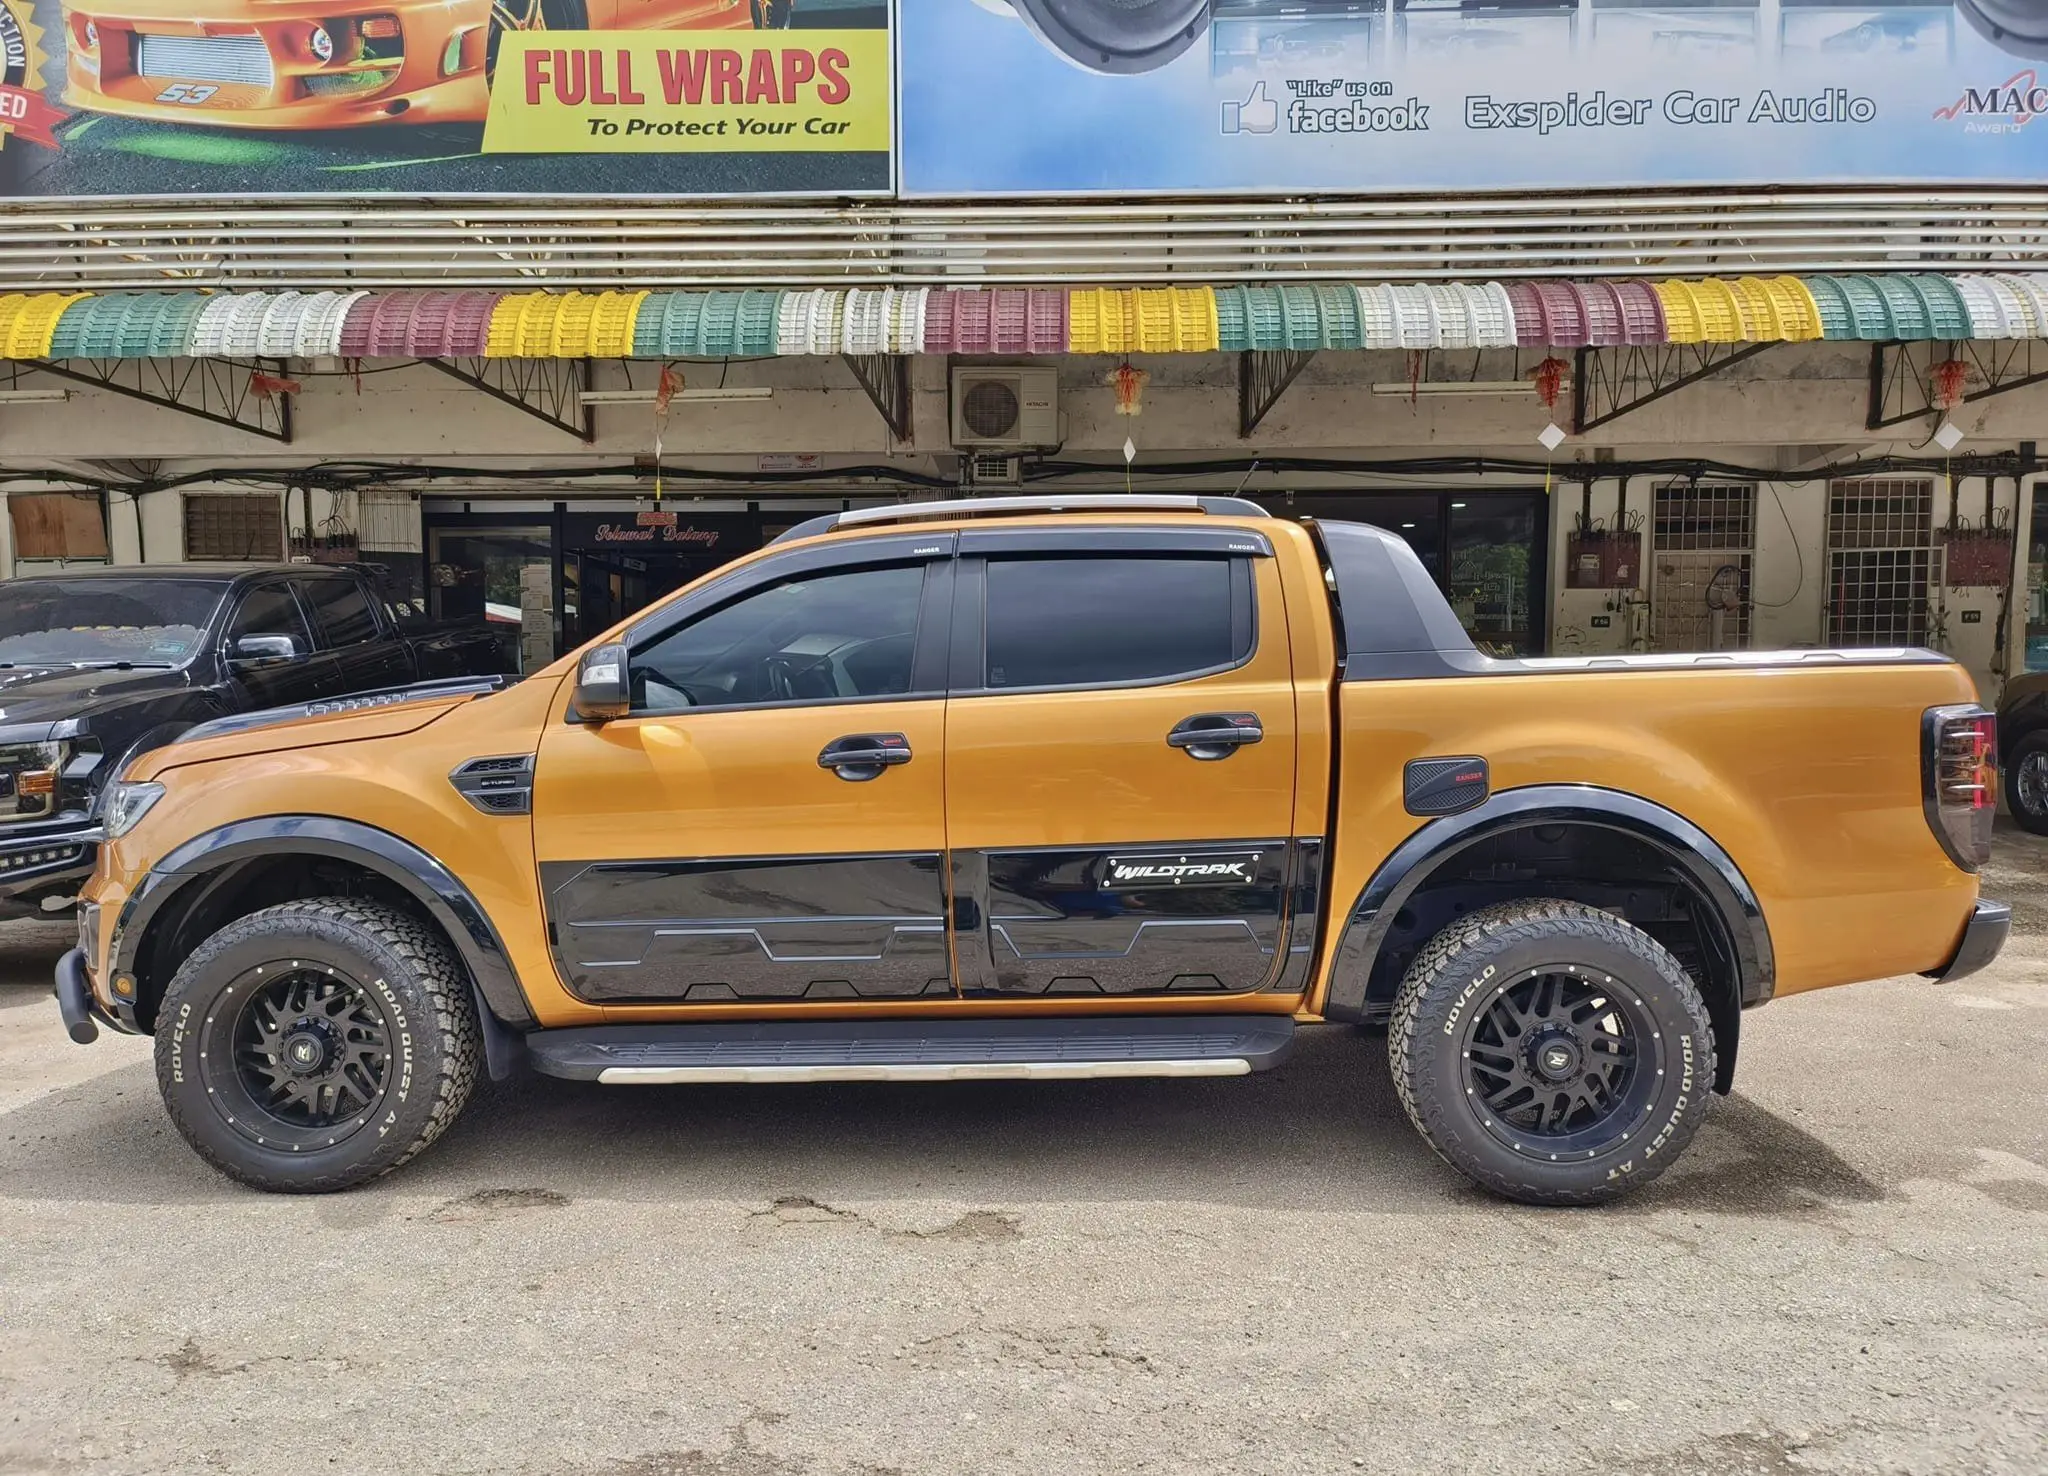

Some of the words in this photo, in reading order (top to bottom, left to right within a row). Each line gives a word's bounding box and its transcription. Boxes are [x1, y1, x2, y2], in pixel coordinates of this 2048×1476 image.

[155, 83, 220, 104] 53
[524, 49, 645, 105] FULL
[656, 47, 851, 105] WRAPS
[1345, 82, 1366, 97] us
[1369, 81, 1393, 96] on
[587, 118, 619, 136] To
[625, 118, 727, 136] Protect
[736, 118, 797, 136] Your
[804, 117, 851, 135] Car
[1288, 97, 1430, 133] facebook
[1465, 90, 1652, 135] Exspider
[1662, 90, 1740, 123] Car
[1748, 88, 1877, 123] Audio
[1964, 121, 2022, 134] Award
[594, 523, 656, 542] Selamat
[662, 524, 719, 547] Datang
[1113, 862, 1247, 880] WILDTRAK
[374, 977, 408, 1029] ROAD
[1443, 964, 1497, 1036] ROVELO
[172, 1003, 191, 1083] ROVELO
[398, 1033, 413, 1103] QUEST
[1680, 1034, 1694, 1092] ROAD
[378, 1110, 397, 1138] AT
[1644, 1095, 1688, 1159] QUEST
[1606, 1160, 1633, 1180] AT
